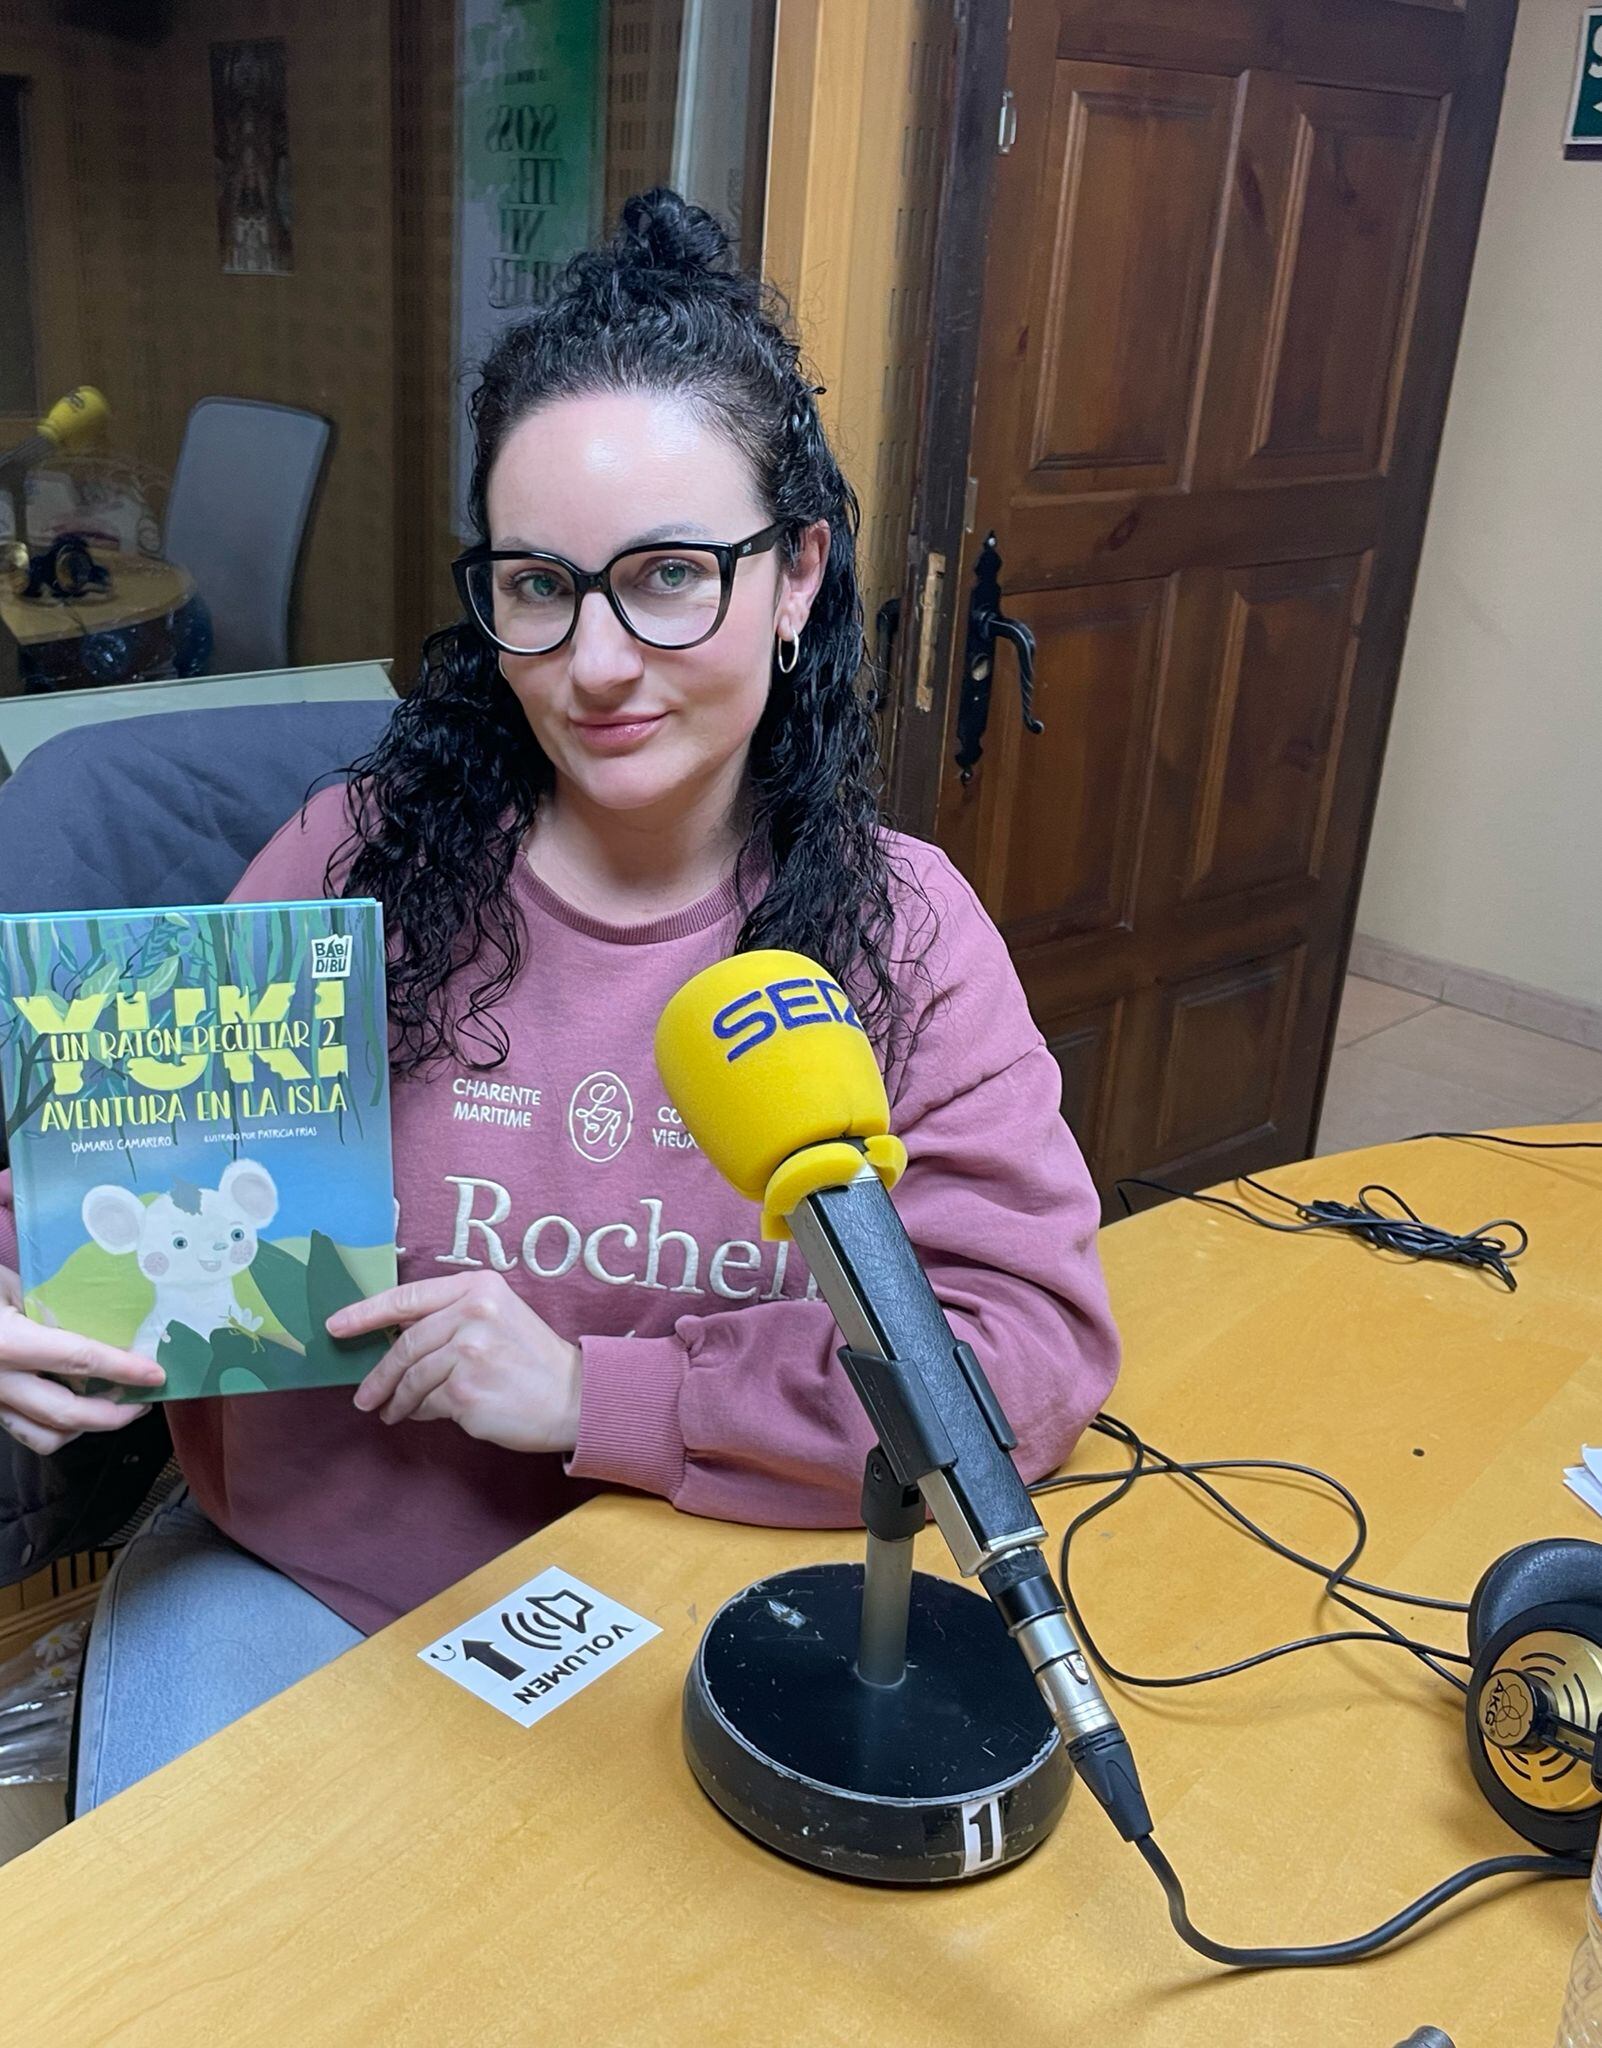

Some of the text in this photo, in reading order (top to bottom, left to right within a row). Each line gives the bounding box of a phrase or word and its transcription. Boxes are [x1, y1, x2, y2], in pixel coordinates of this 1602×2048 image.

[13, 980, 348, 1096] YUKI
[51, 1018, 340, 1062] UN RATÓN PECULIAR 2
[41, 1082, 348, 1132] AVENTURA EN LA ISLA
[452, 1077, 543, 1107] CHARENTE
[452, 1101, 533, 1128] MARITIME
[512, 1623, 635, 1705] VOLUMEN
[968, 1802, 994, 1863] 1
